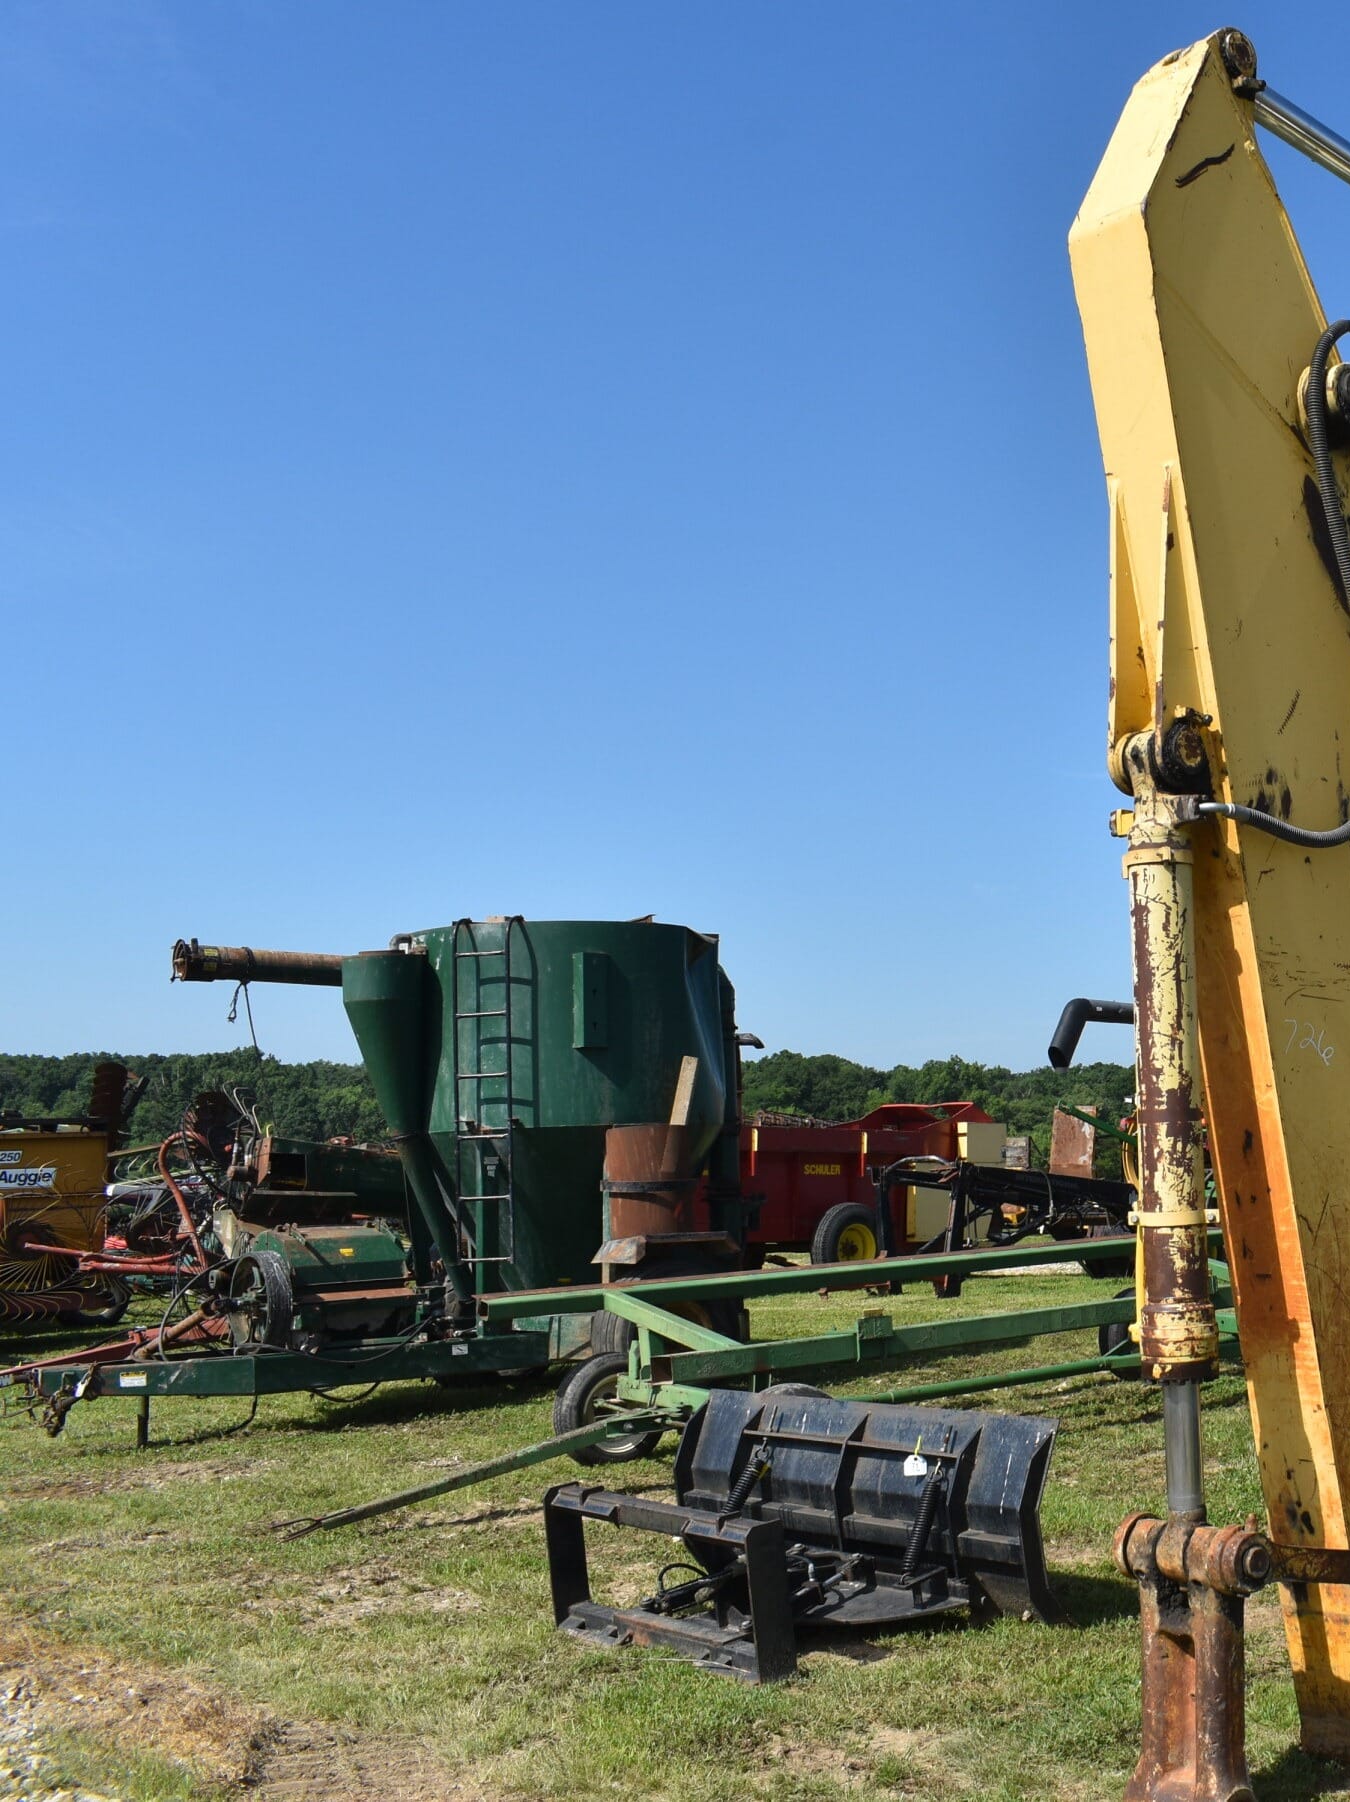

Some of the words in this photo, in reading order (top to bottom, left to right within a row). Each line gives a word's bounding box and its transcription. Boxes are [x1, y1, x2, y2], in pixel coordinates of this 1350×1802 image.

[1284, 1019, 1335, 1067] 726
[0, 1170, 52, 1186] Auggie
[803, 1164, 841, 1176] SCHULER
